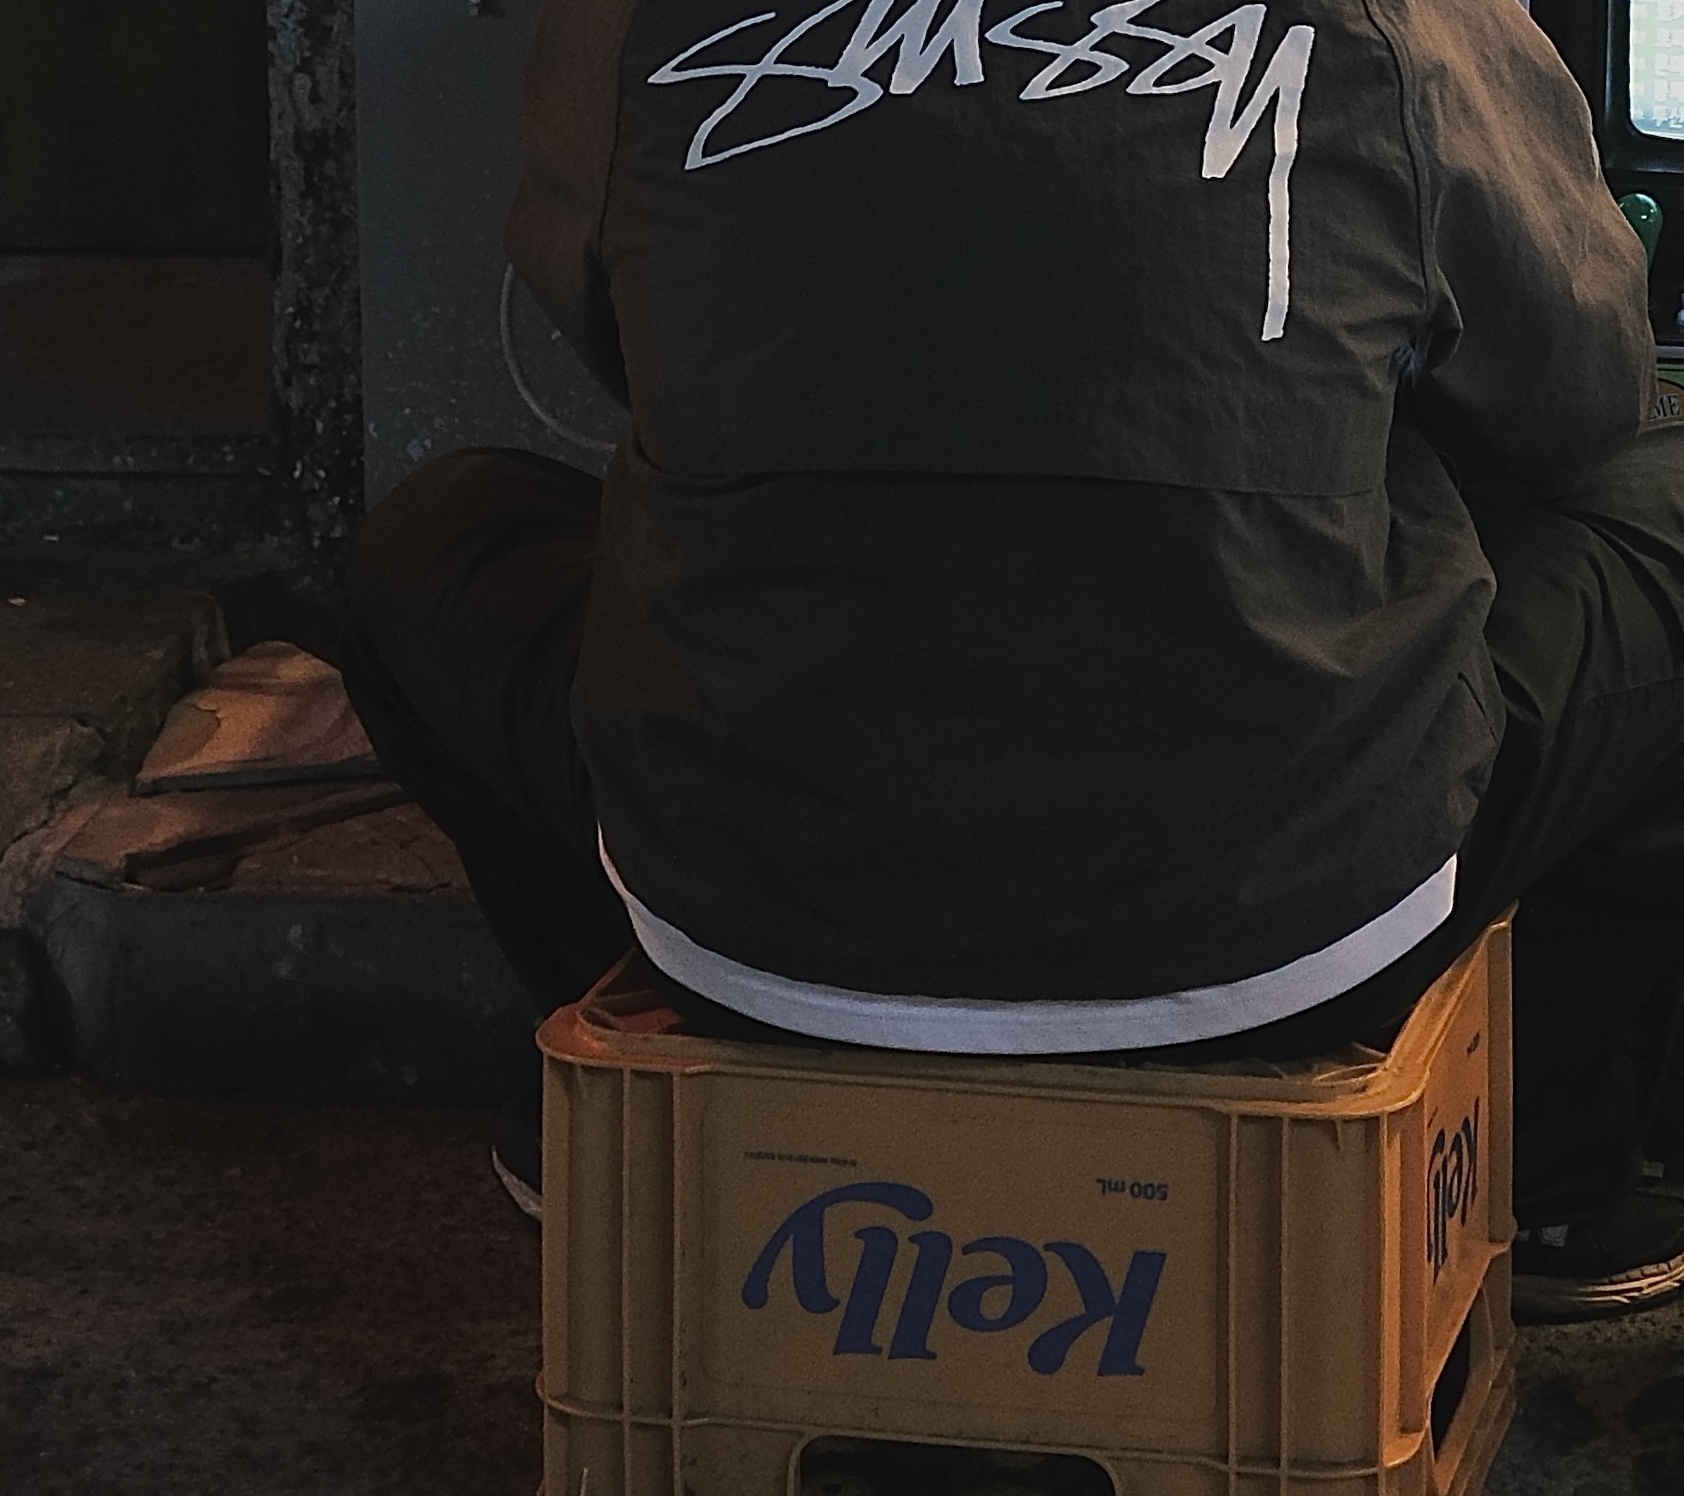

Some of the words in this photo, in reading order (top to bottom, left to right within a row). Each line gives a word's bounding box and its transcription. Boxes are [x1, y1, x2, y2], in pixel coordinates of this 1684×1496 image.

[1095, 1177, 1127, 1196] mL
[1130, 1180, 1169, 1202] 500
[740, 1181, 1167, 1377] Kelly
